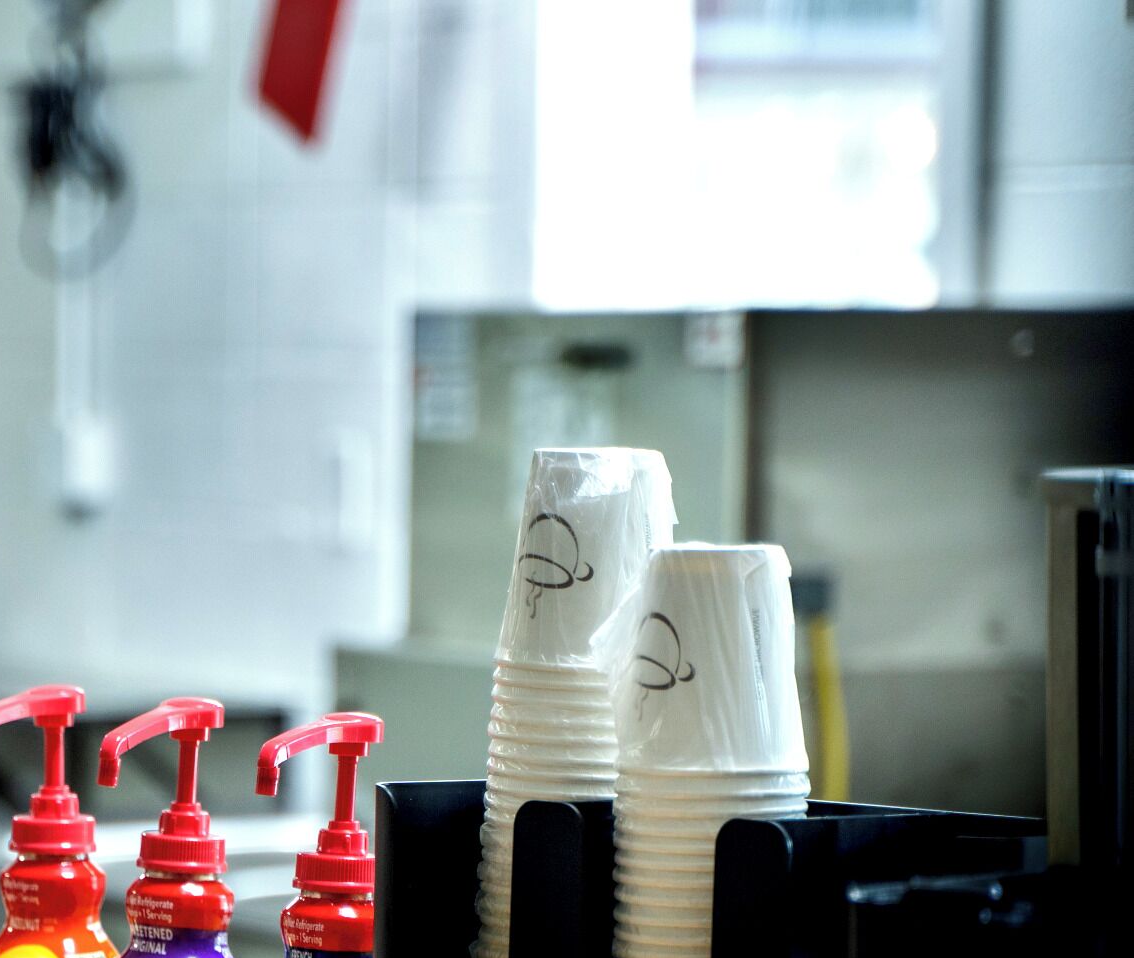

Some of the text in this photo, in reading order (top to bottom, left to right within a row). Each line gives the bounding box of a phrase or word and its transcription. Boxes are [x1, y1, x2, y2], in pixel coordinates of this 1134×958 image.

[146, 909, 172, 924] Serving
[296, 917, 324, 932] Refrigerate
[132, 924, 174, 941] EETENED
[302, 932, 323, 947] Serving
[130, 938, 168, 956] IGINAL
